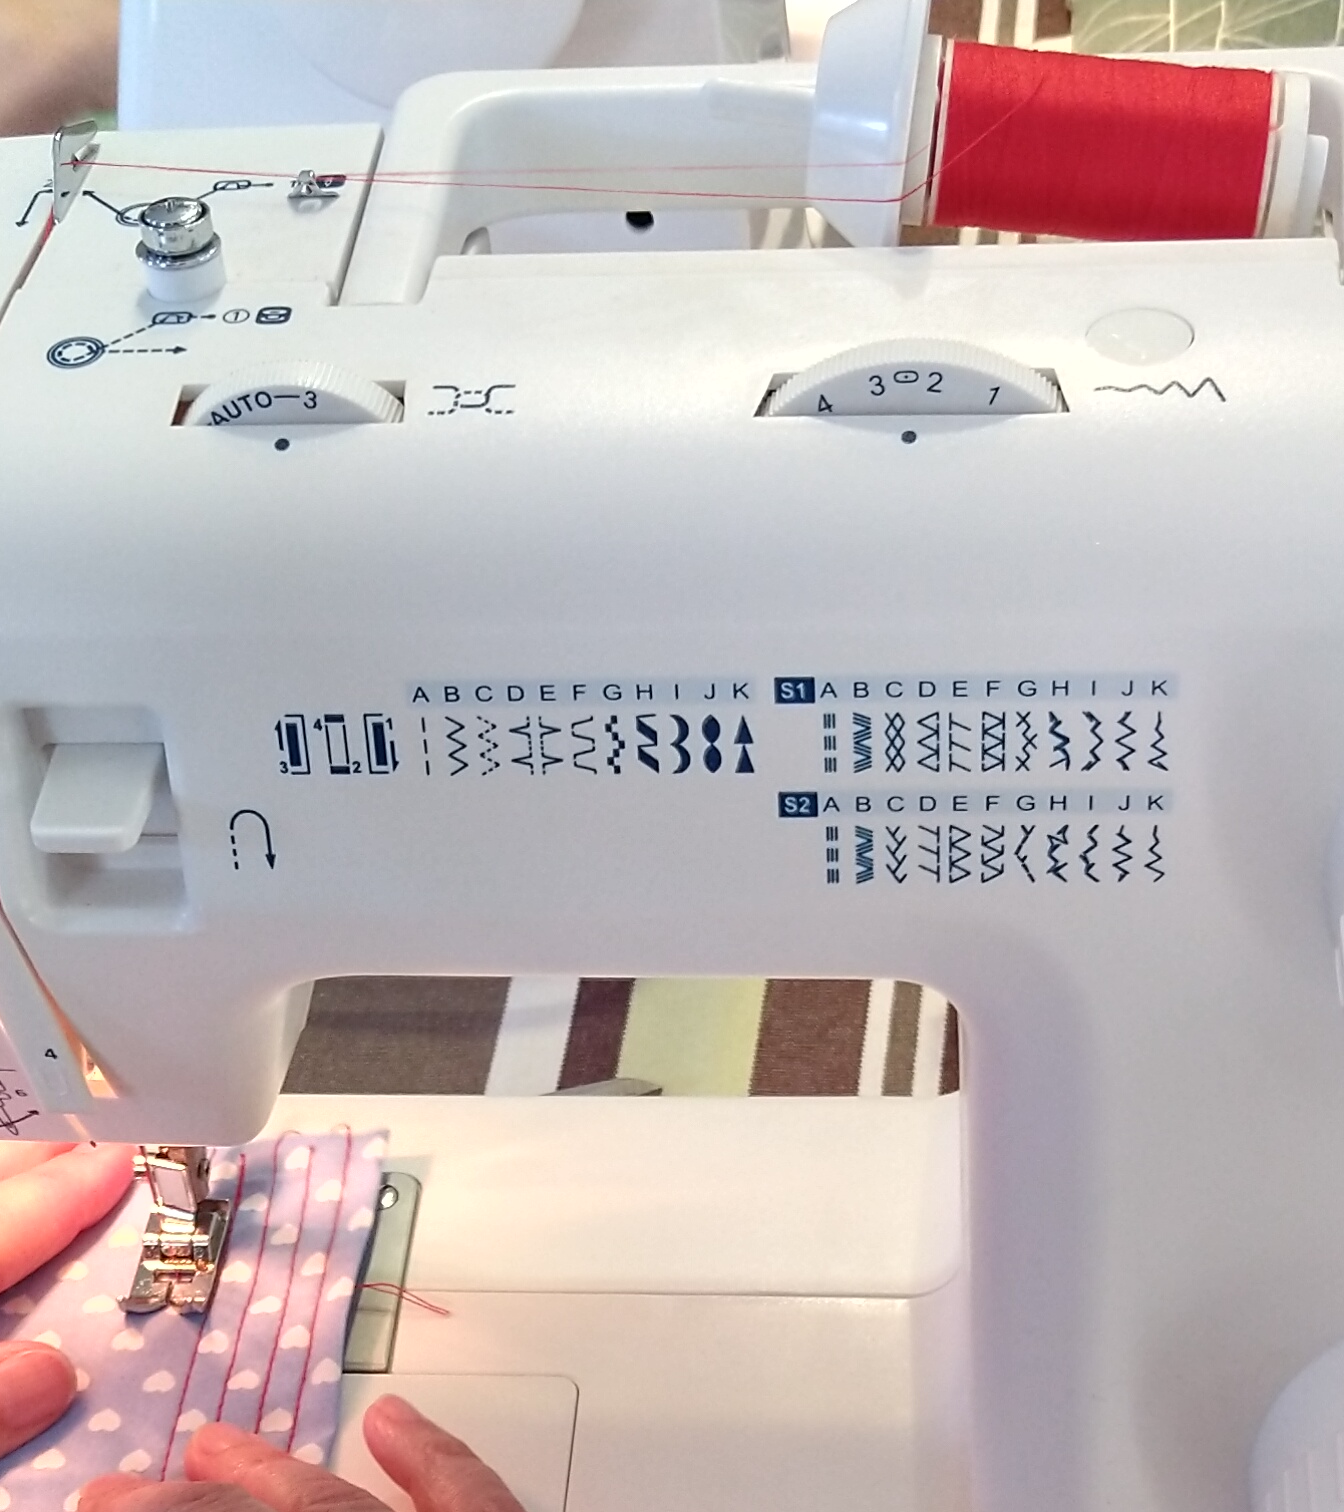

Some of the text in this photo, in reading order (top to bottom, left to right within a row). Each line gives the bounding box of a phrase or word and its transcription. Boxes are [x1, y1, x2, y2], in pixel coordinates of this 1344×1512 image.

[818, 372, 1000, 413] 4 3 2 1
[780, 681, 806, 700] S1
[784, 796, 810, 815] S2
[44, 1048, 58, 1060] 4
